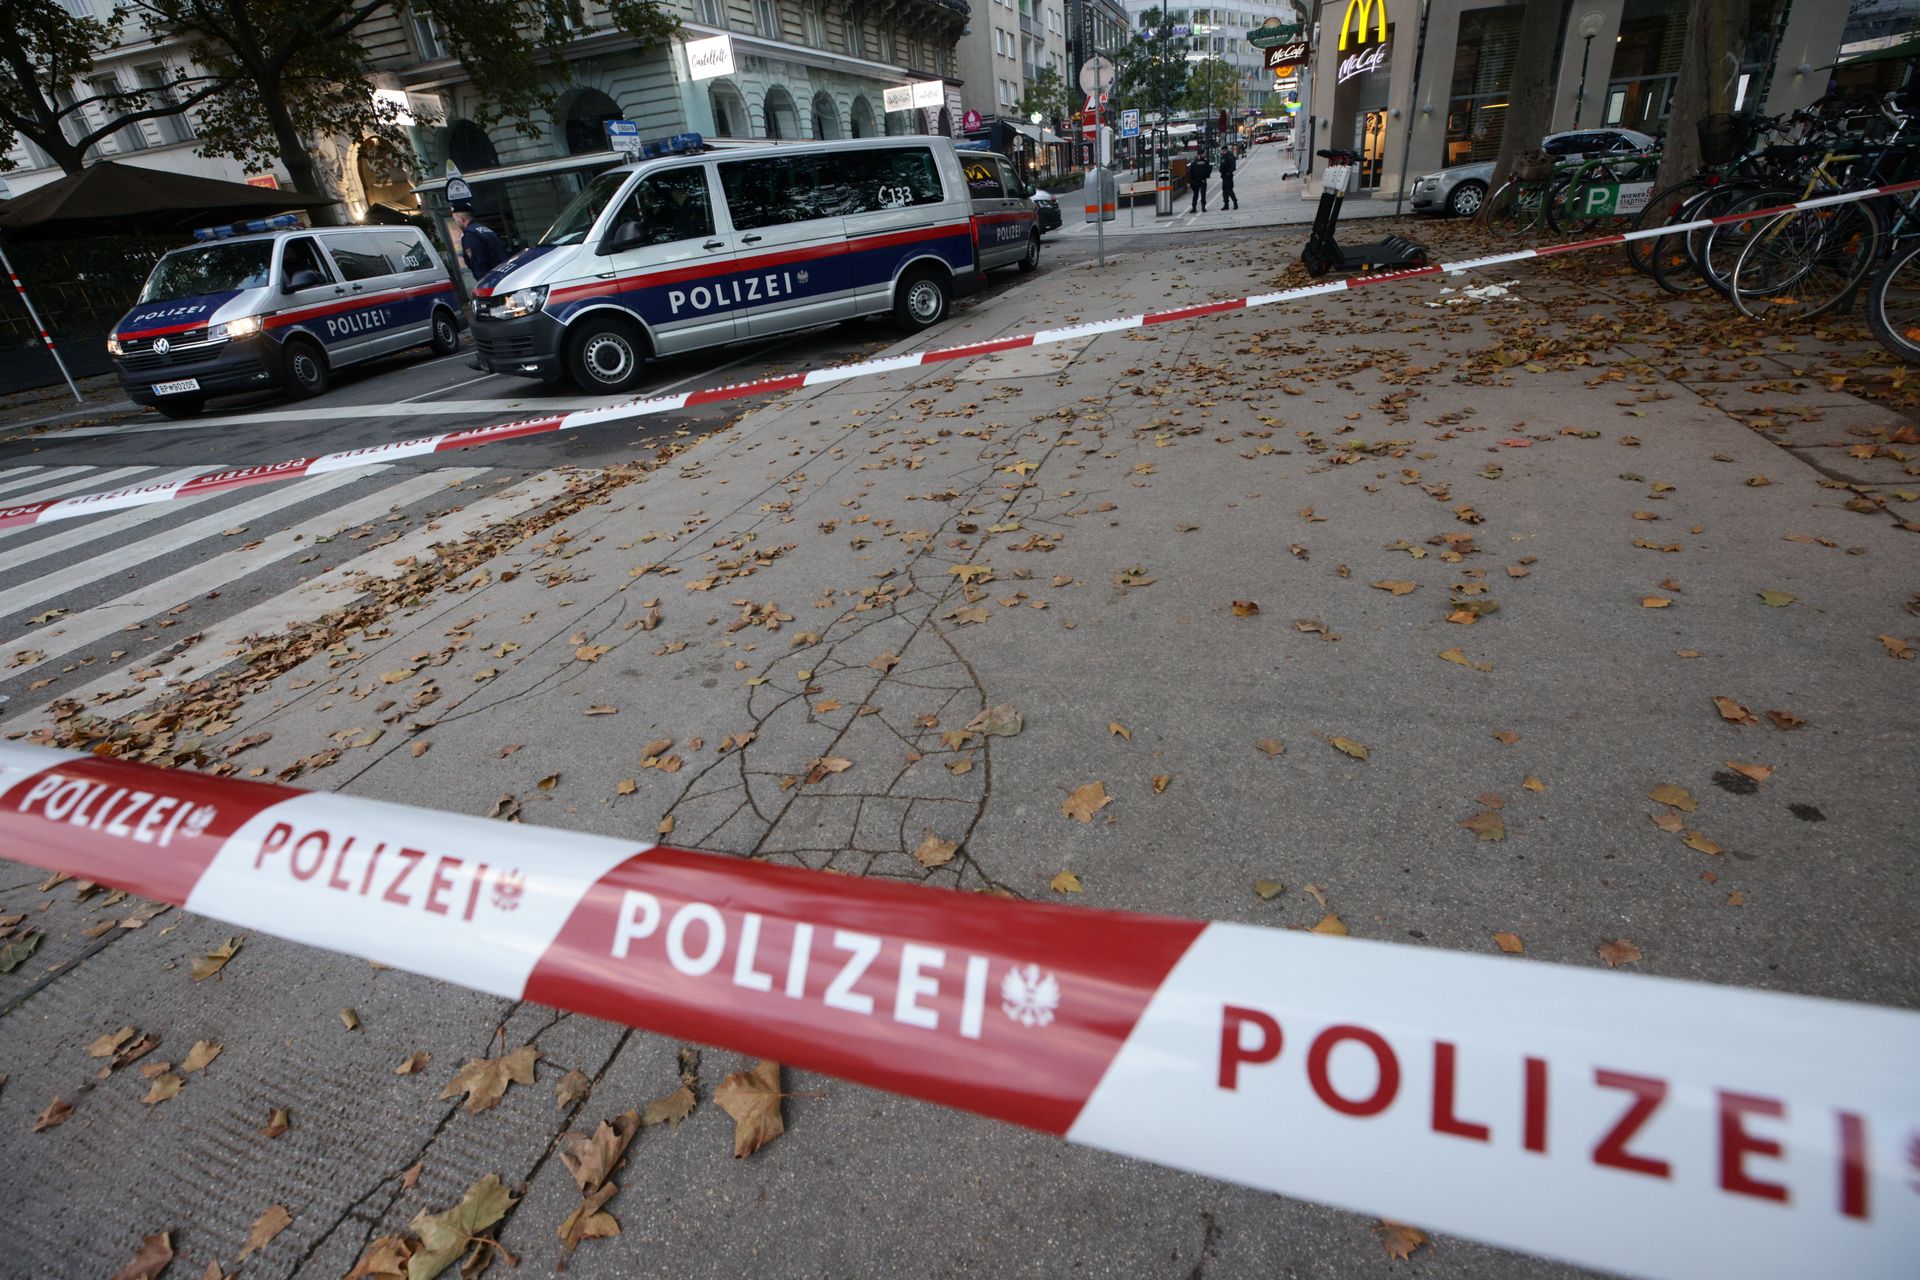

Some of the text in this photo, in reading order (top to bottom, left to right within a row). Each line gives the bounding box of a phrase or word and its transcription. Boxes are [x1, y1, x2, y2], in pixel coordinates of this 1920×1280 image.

[1338, 43, 1388, 85] McCafé
[888, 186, 912, 203] 133
[1585, 187, 1610, 215] P
[996, 224, 1021, 241] POLIZEI
[668, 272, 792, 314] POLIZEI
[133, 304, 207, 322] POLIZEI
[327, 309, 386, 337] POLIZEI
[214, 457, 306, 481] POLIZEI
[17, 773, 192, 847] POLIZEI
[252, 822, 489, 922] POLIZEI
[610, 890, 990, 1039] POLIZEI
[1216, 1003, 1874, 1224] POLIZEI
